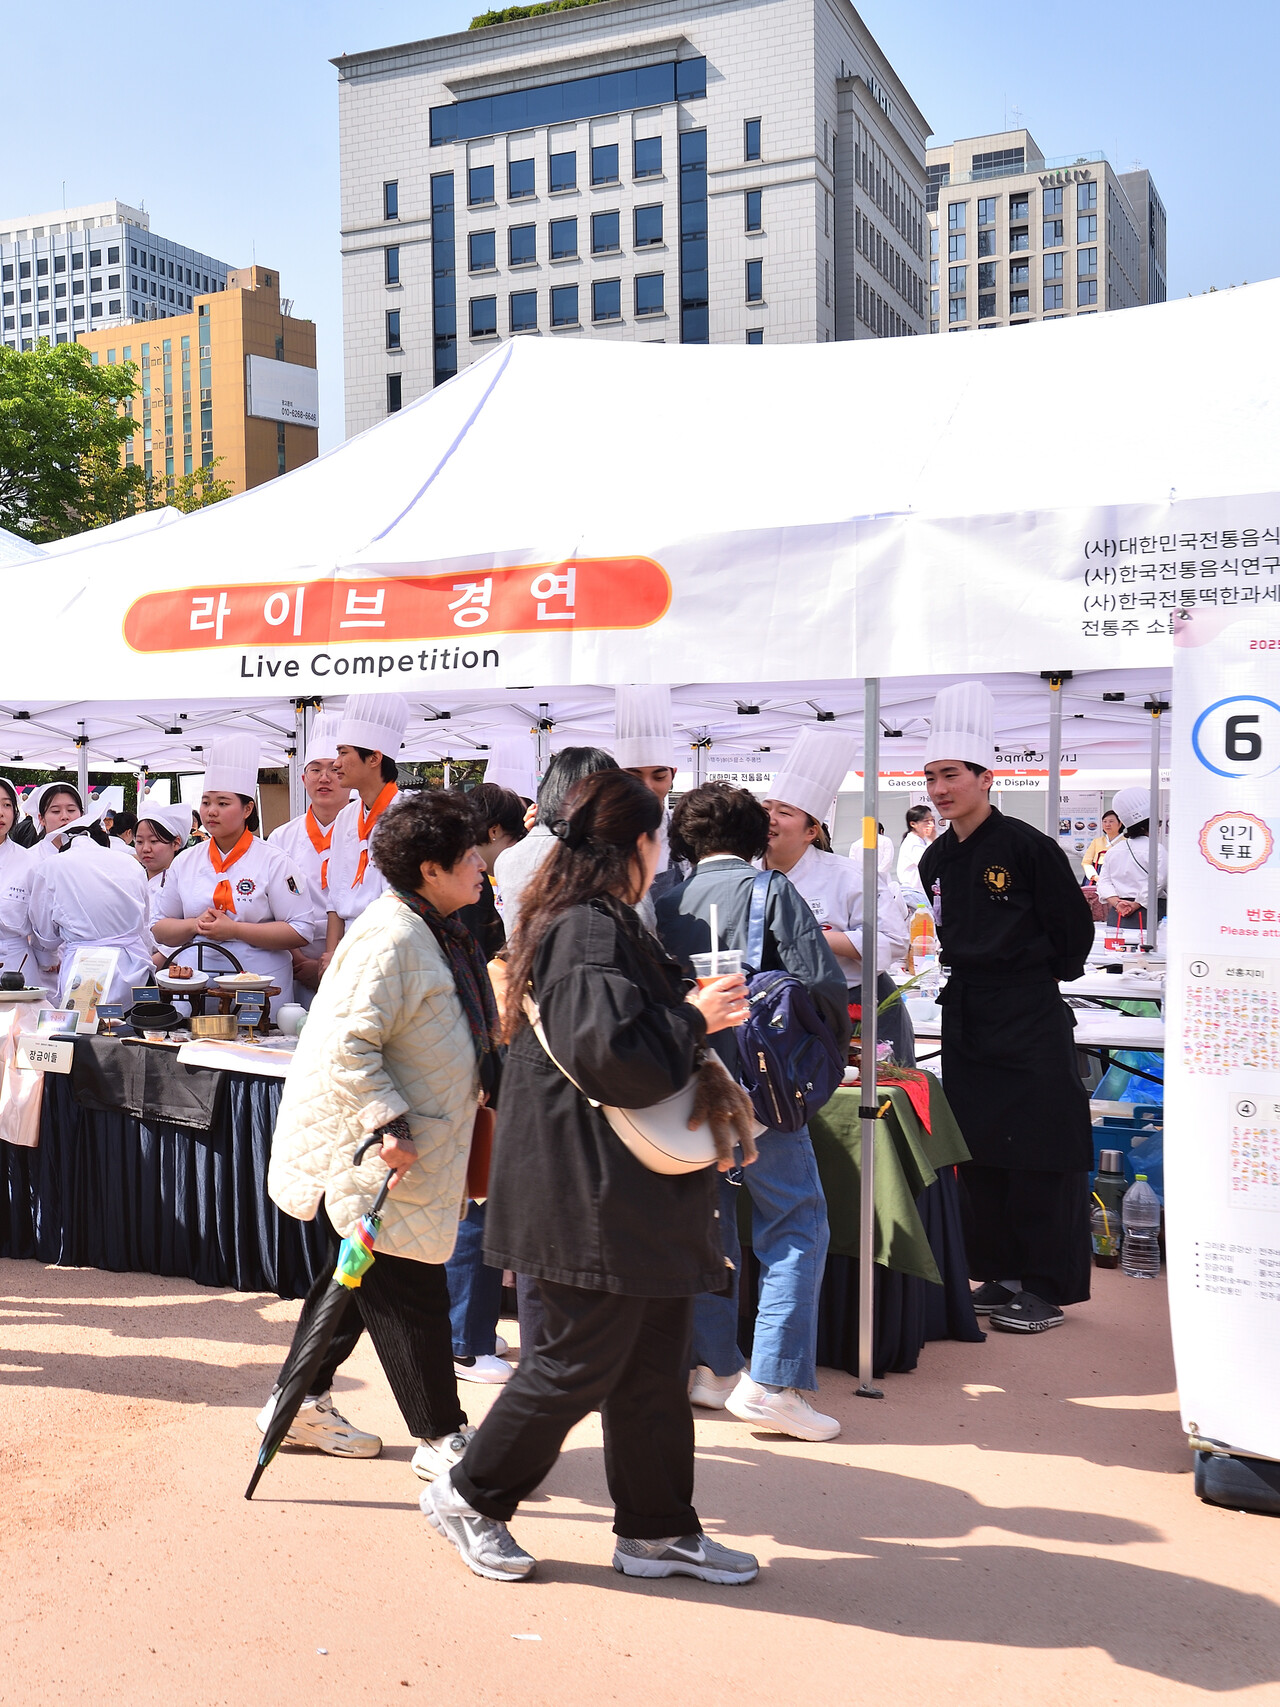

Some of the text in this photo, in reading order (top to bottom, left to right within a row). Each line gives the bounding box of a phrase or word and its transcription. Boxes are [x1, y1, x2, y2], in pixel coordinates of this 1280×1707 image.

[190, 568, 576, 640] 라이브 경연
[1081, 619, 1140, 637] 전통주
[1249, 640, 1280, 650] 202
[240, 646, 499, 678] Live Competition
[1225, 715, 1262, 761] 6
[1004, 778, 1040, 787] Display
[1220, 825, 1252, 841] 인기
[1219, 845, 1252, 859] 투표
[1246, 909, 1280, 922] 번호
[1220, 925, 1259, 937] Please
[29, 1050, 57, 1063] 장금이들
